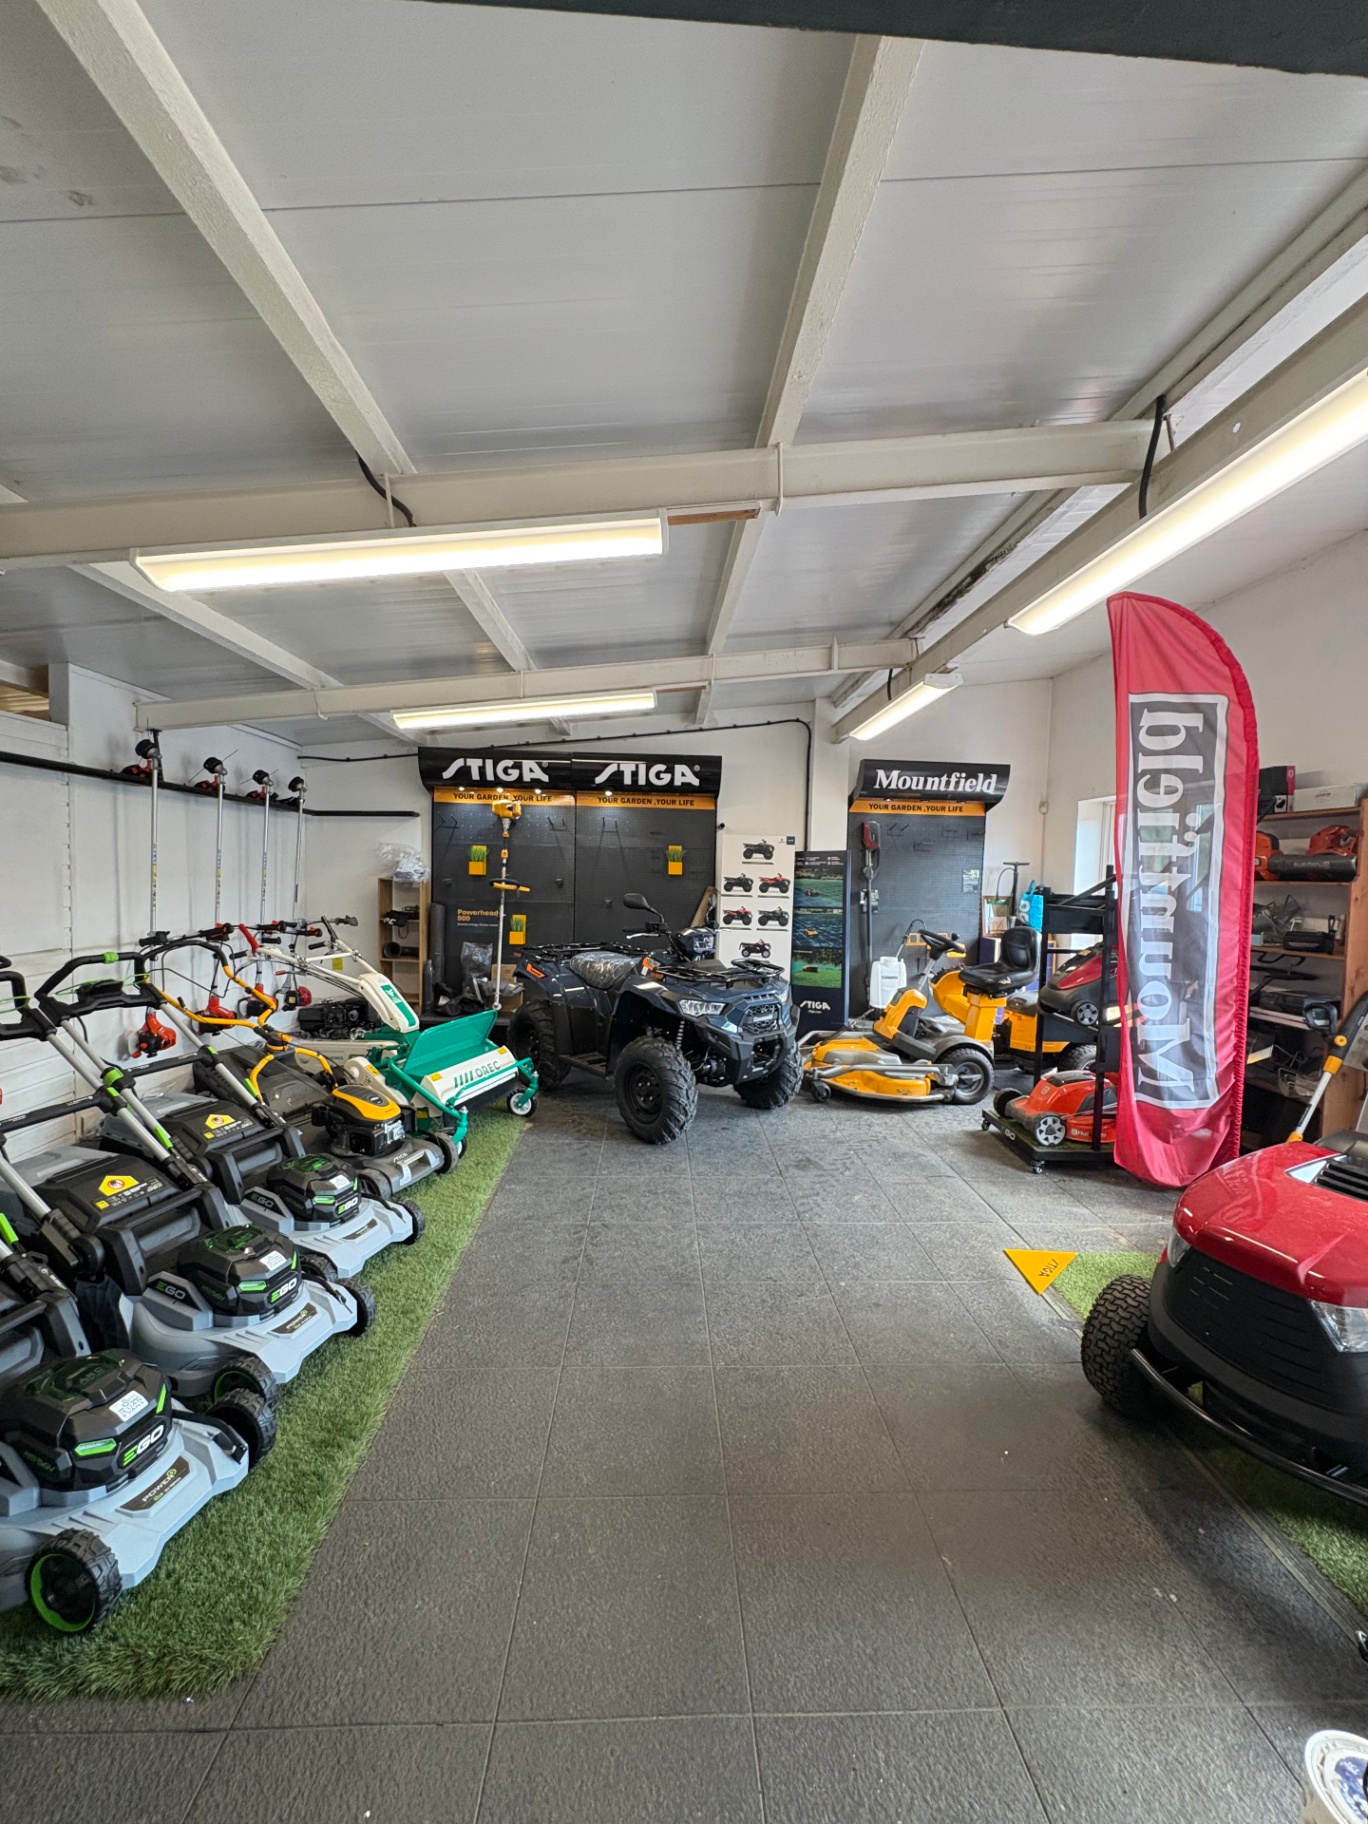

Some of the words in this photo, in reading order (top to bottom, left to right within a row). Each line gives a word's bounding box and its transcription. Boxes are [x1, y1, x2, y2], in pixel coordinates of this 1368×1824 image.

[442, 757, 549, 782] STIGA
[595, 763, 699, 787] STIGA
[873, 769, 997, 793] Mountfield
[453, 792, 475, 800] YOUR
[476, 793, 509, 801] GARDEN
[597, 796, 619, 804] YOUR
[620, 797, 653, 805] GARDEN
[678, 799, 695, 807] LIFE
[868, 803, 889, 811] YOUR
[947, 805, 964, 813] LIFE
[799, 1000, 831, 1011] STIGA
[475, 1061, 501, 1078] OREC
[393, 1152, 408, 1163] STIGA
[250, 1193, 274, 1209] EGO
[337, 1197, 359, 1215] EGO
[155, 1280, 186, 1300] EGO
[270, 1278, 297, 1303] EGO
[122, 1424, 164, 1467] EGO
